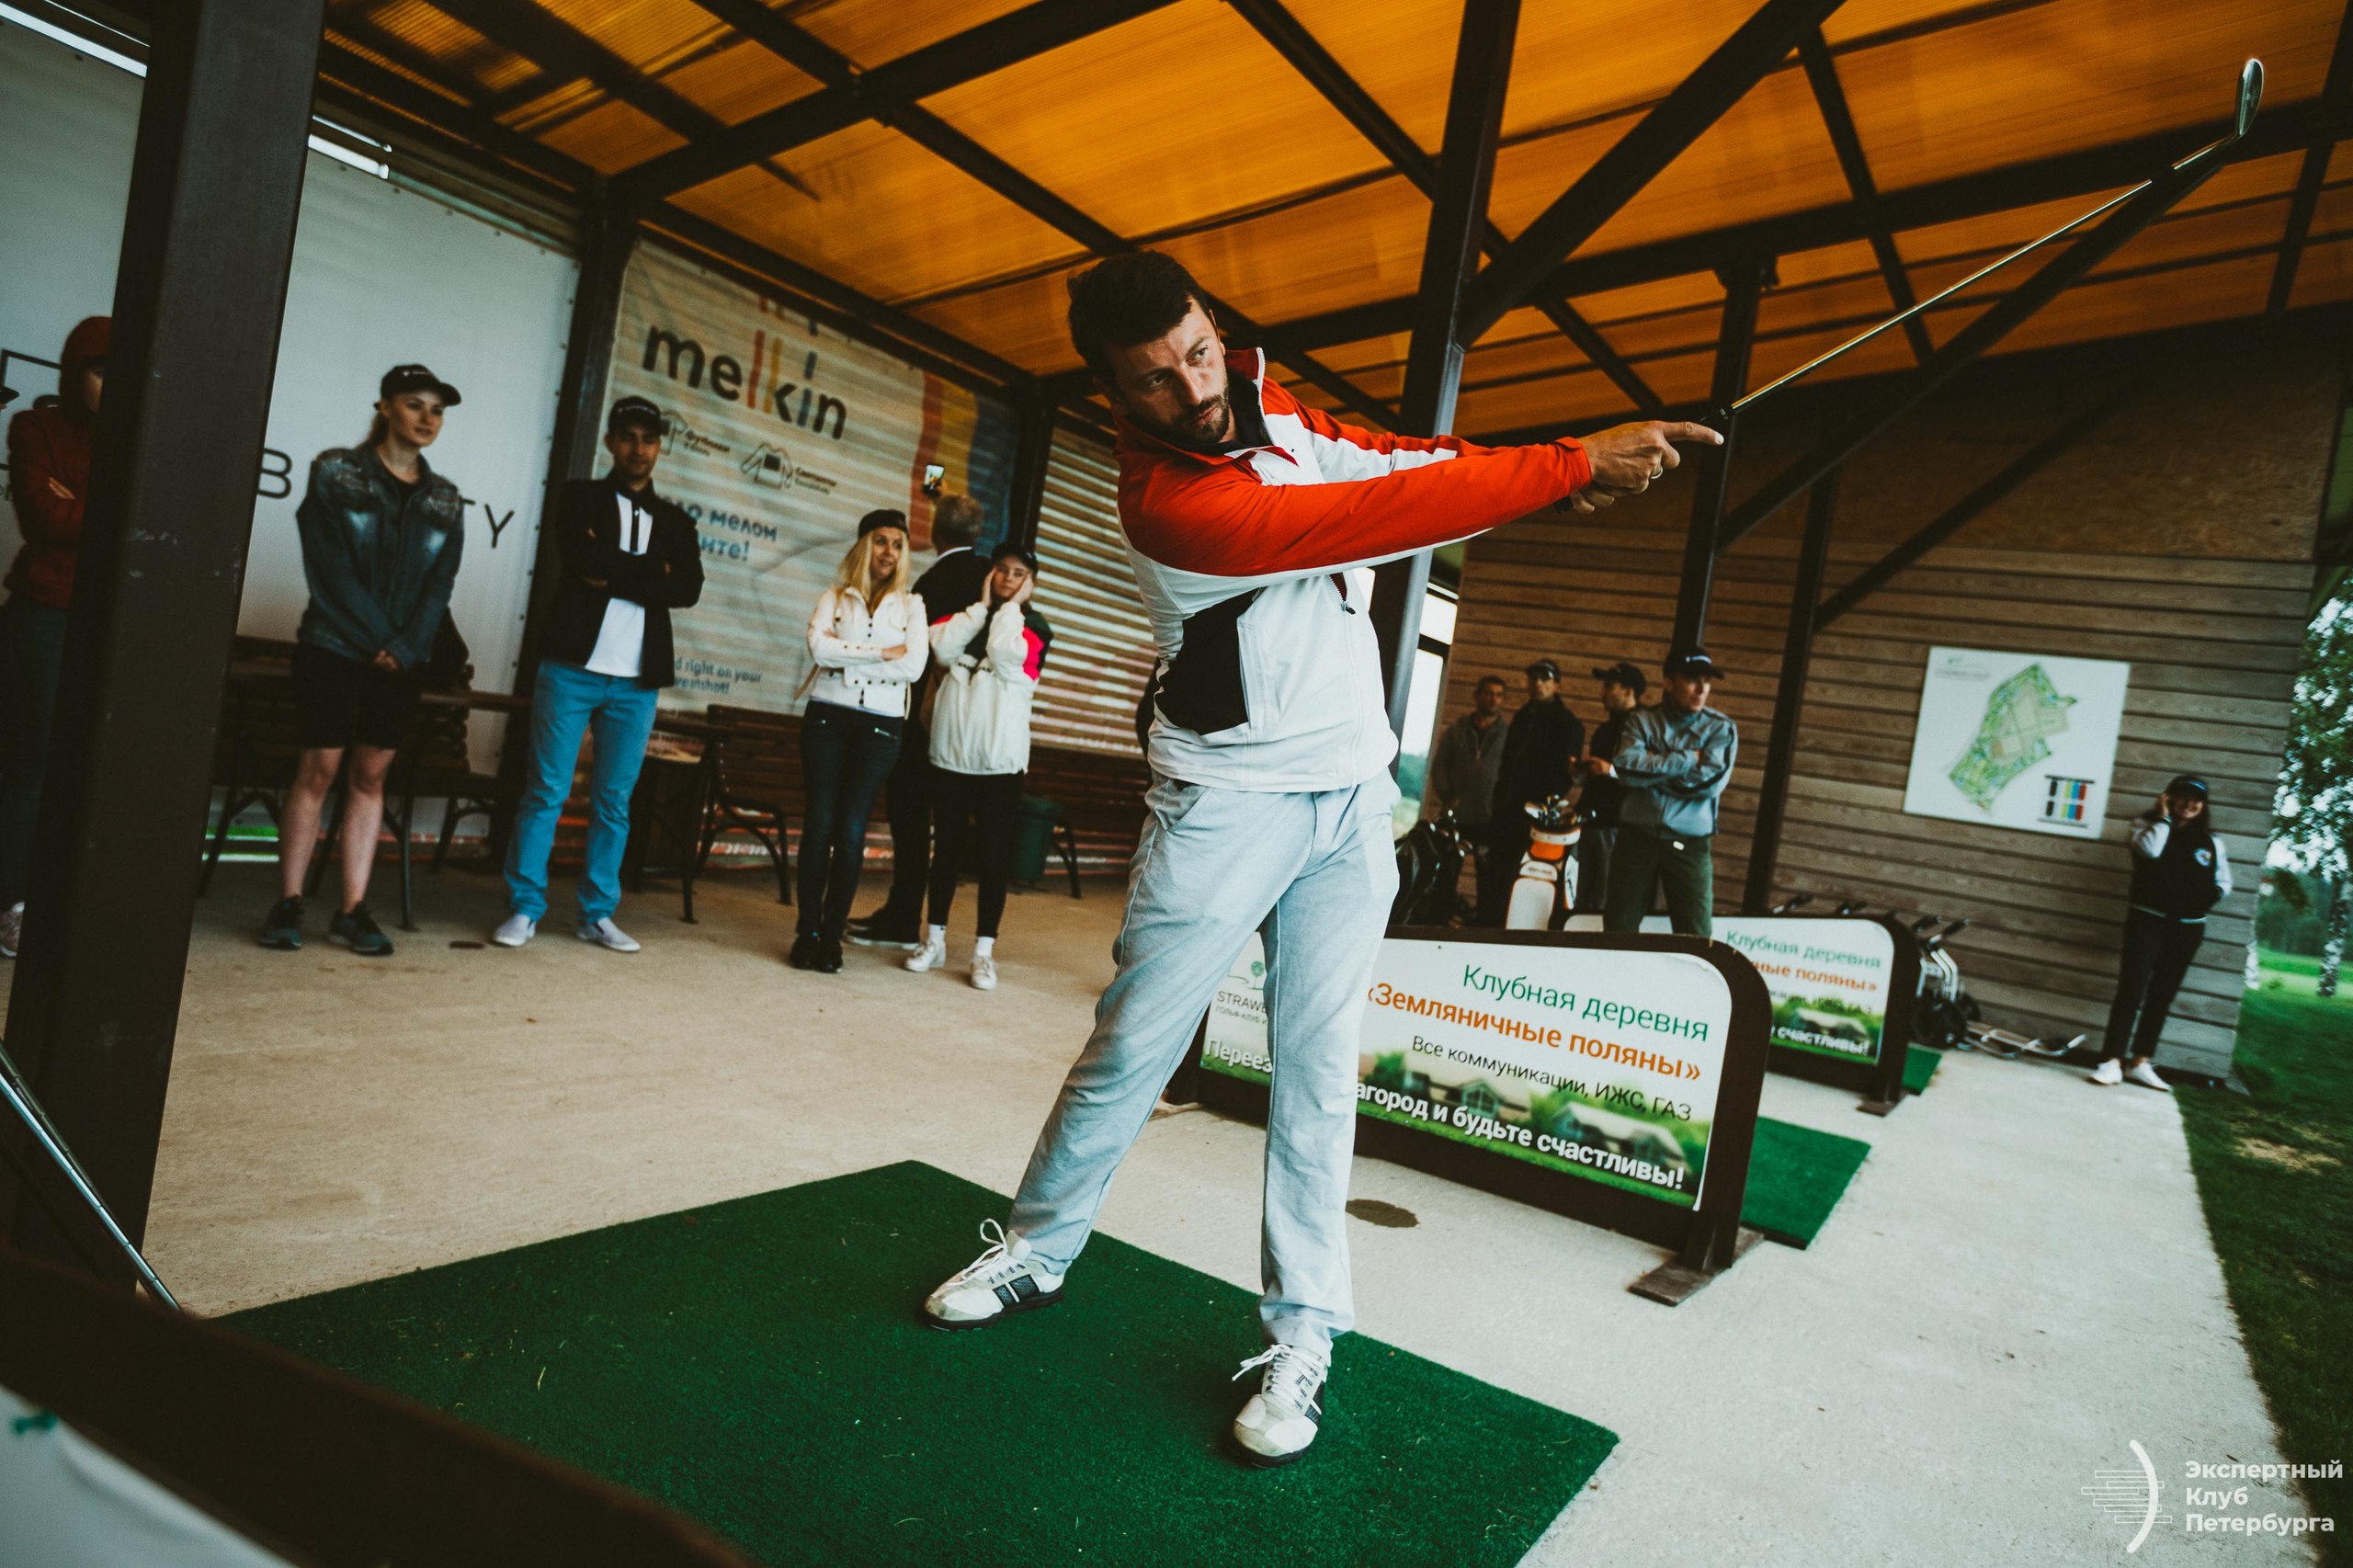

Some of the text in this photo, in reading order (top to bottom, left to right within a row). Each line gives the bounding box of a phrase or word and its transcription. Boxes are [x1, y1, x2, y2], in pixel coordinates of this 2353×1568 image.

[642, 324, 847, 440] melkin
[710, 509, 779, 542] мелом
[700, 536, 750, 562] ите!
[1724, 930, 1881, 971] Клубная деревня
[1750, 960, 1791, 977] ные
[1216, 990, 1267, 1013] STRAW
[1462, 963, 1710, 1042] Клубная деревня
[1411, 1035, 1443, 1057] Все
[1447, 1043, 1589, 1097] коммуникации,
[1652, 1097, 1693, 1122] ГАЗ
[1568, 1032, 1702, 1082] поляны»
[1204, 1040, 1687, 1190] Переез агород и будьте счастливы!
